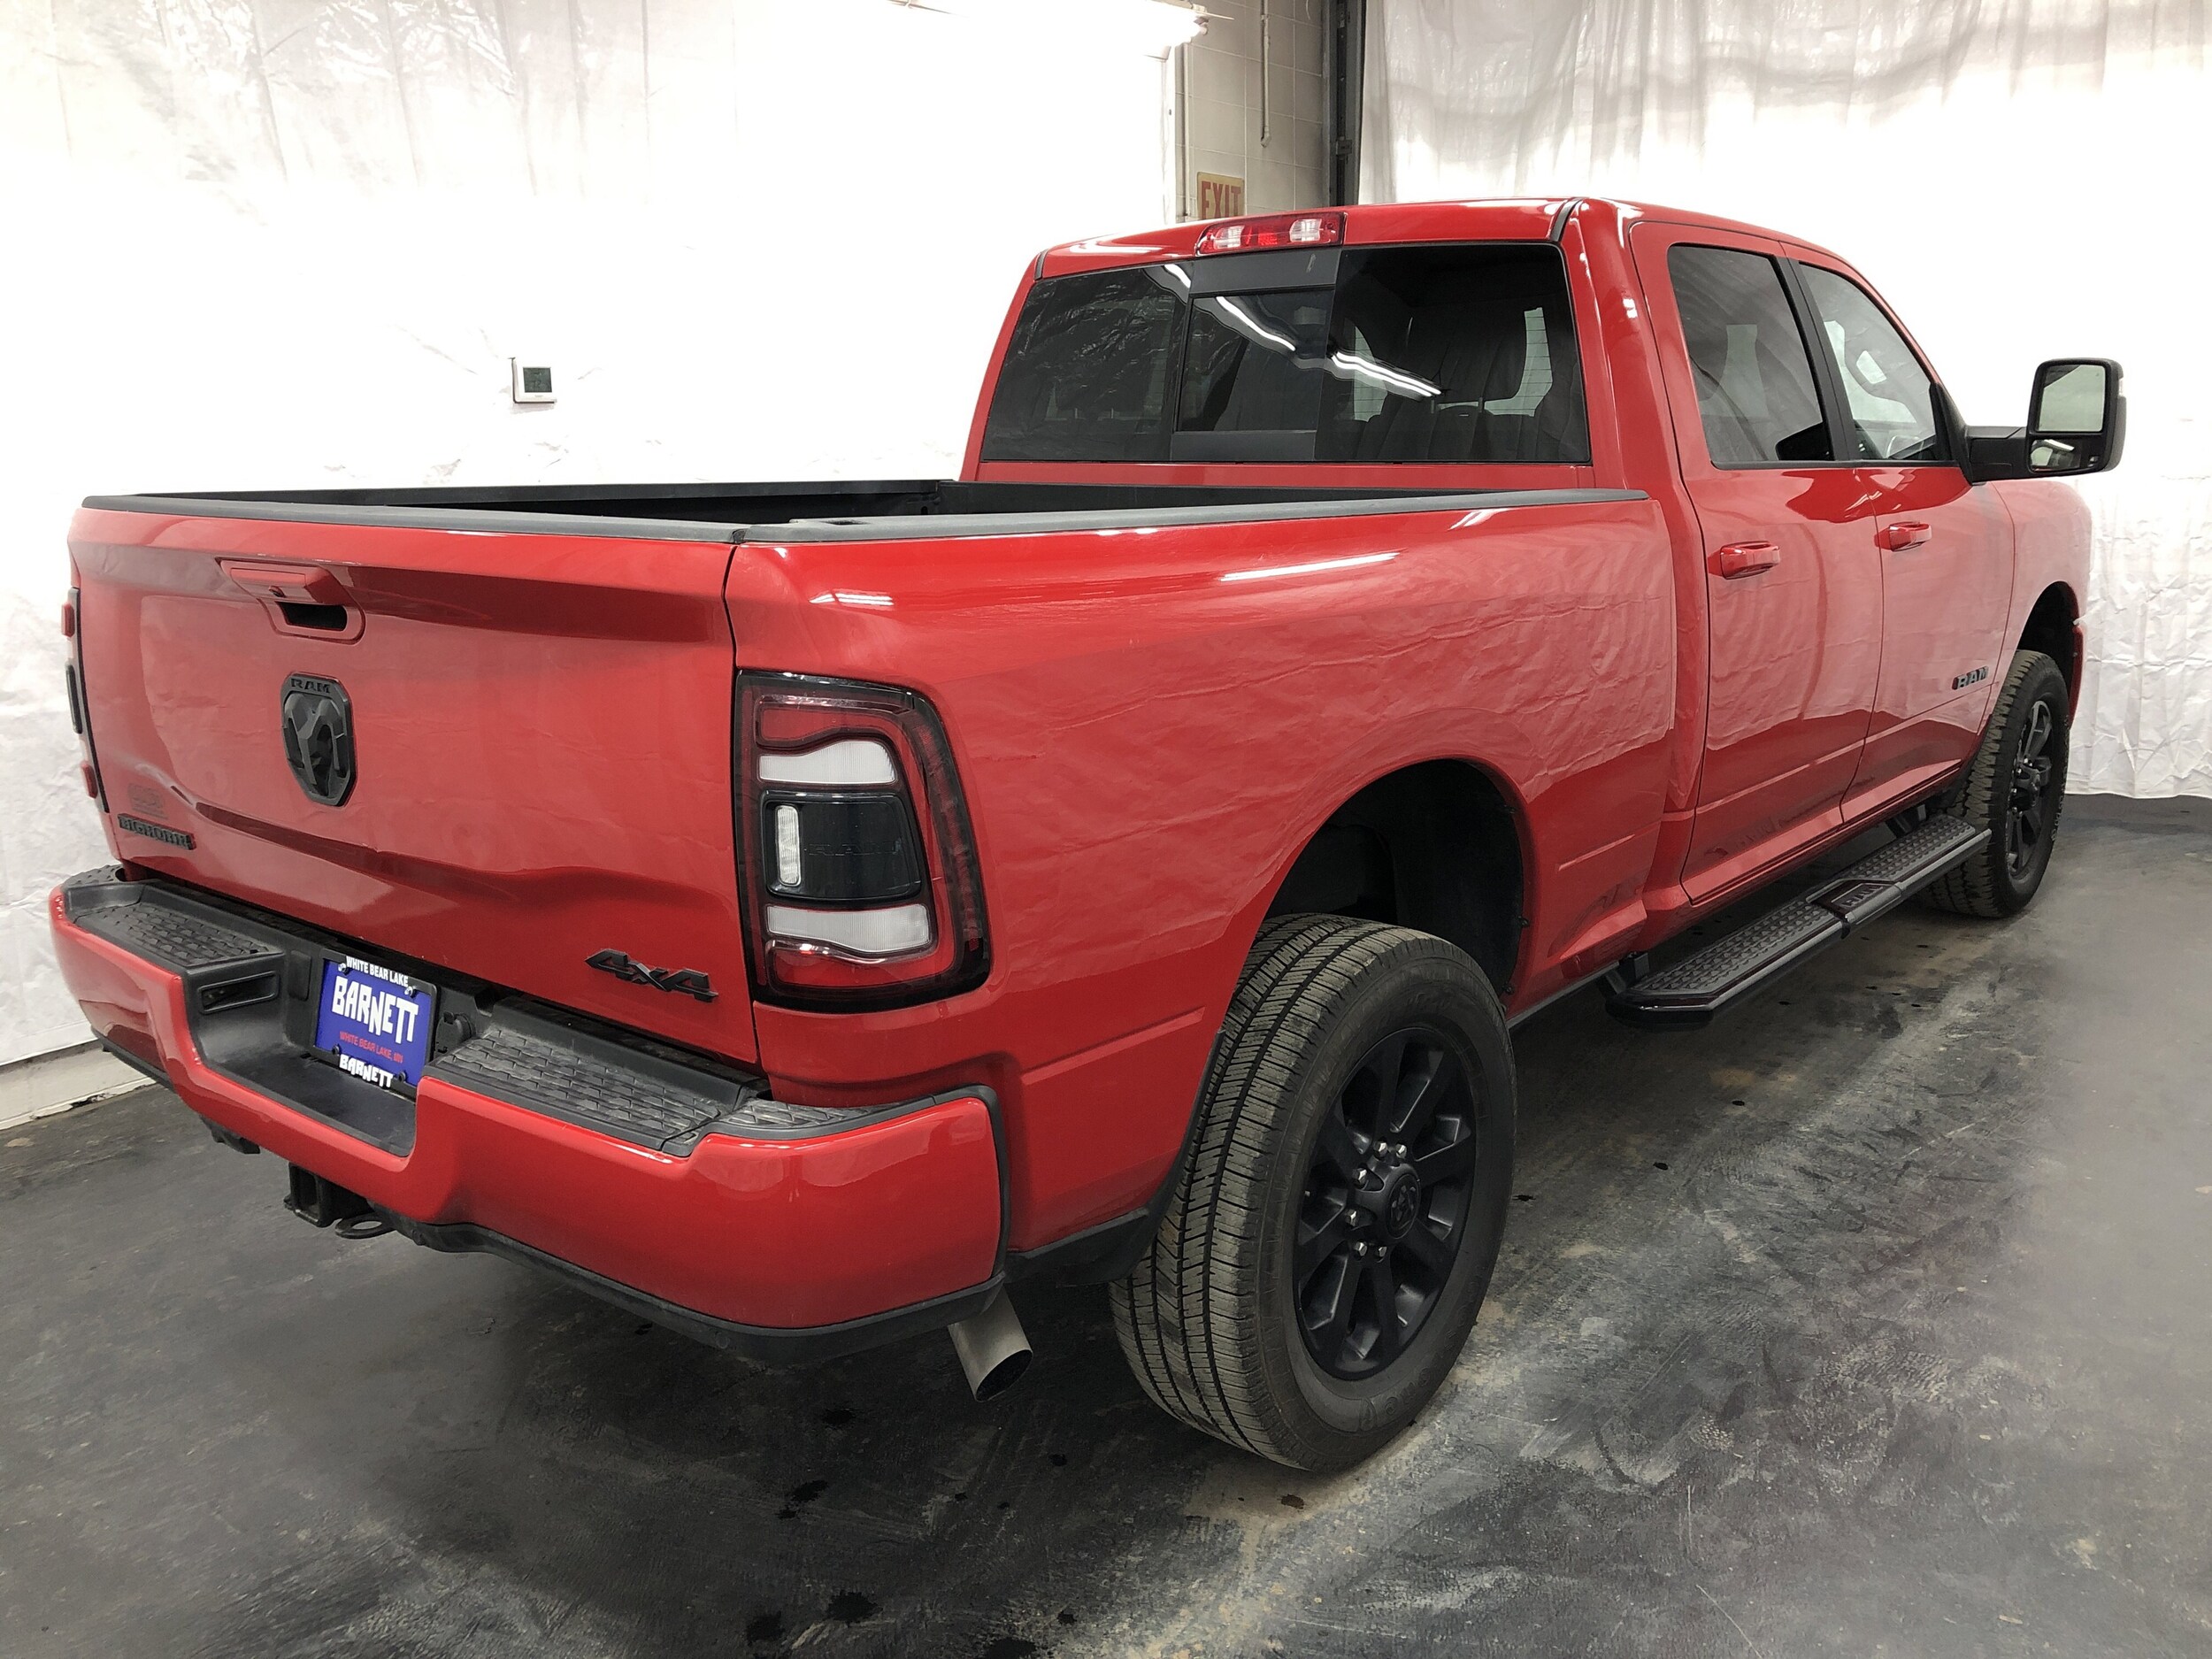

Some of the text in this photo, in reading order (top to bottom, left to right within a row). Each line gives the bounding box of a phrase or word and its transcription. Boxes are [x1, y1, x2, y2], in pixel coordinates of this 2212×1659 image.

[1201, 180, 1241, 219] EXIT
[290, 678, 331, 694] RAM
[1952, 665, 1989, 690] RAM
[346, 956, 410, 987] WHITE BEAR LAKE
[331, 975, 419, 1045] BARNETT
[339, 1031, 359, 1046] WHITE
[358, 1038, 376, 1052] BEAR
[339, 1054, 394, 1087] BARNETT
